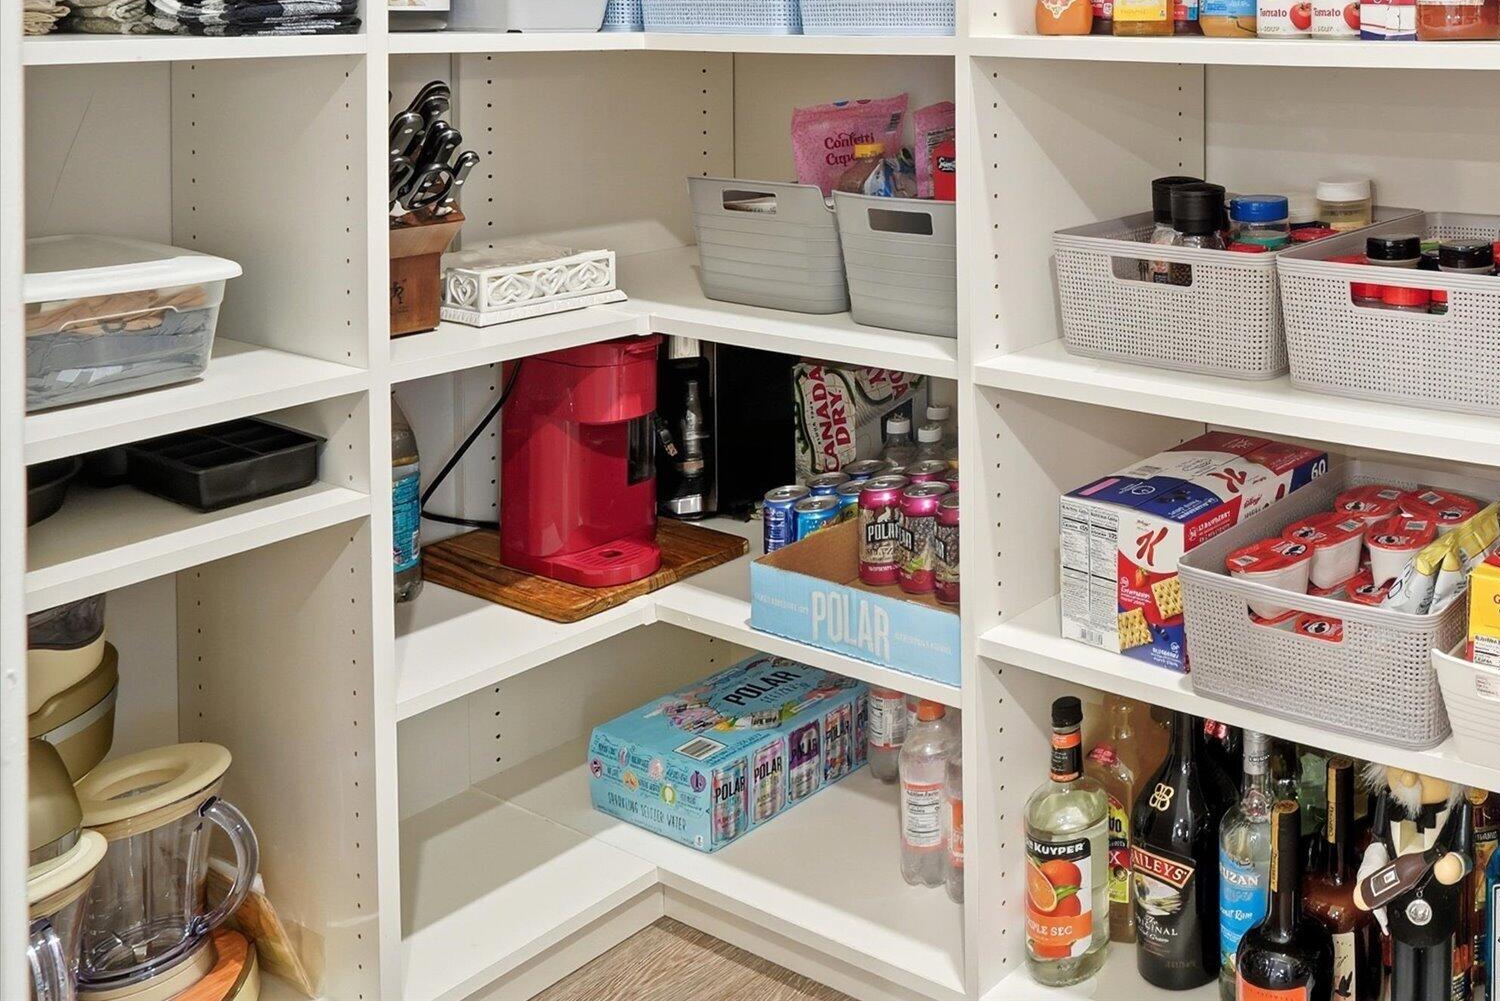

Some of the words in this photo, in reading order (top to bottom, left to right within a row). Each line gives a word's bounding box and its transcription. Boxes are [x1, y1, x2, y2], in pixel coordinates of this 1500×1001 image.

[1260, 7, 1287, 18] Tomato
[824, 131, 876, 150] Confetti
[826, 152, 856, 166] Cup
[807, 364, 841, 473] CANADA
[830, 389, 852, 447] DRY
[1311, 458, 1327, 480] 60
[811, 590, 891, 664] POLAR
[723, 670, 802, 707] POLAR
[753, 756, 783, 784] POLAR
[715, 776, 746, 804] POLAR
[1131, 848, 1187, 881] AILEYS
[1219, 864, 1261, 887] UZAN
[1050, 924, 1073, 937] SEC
